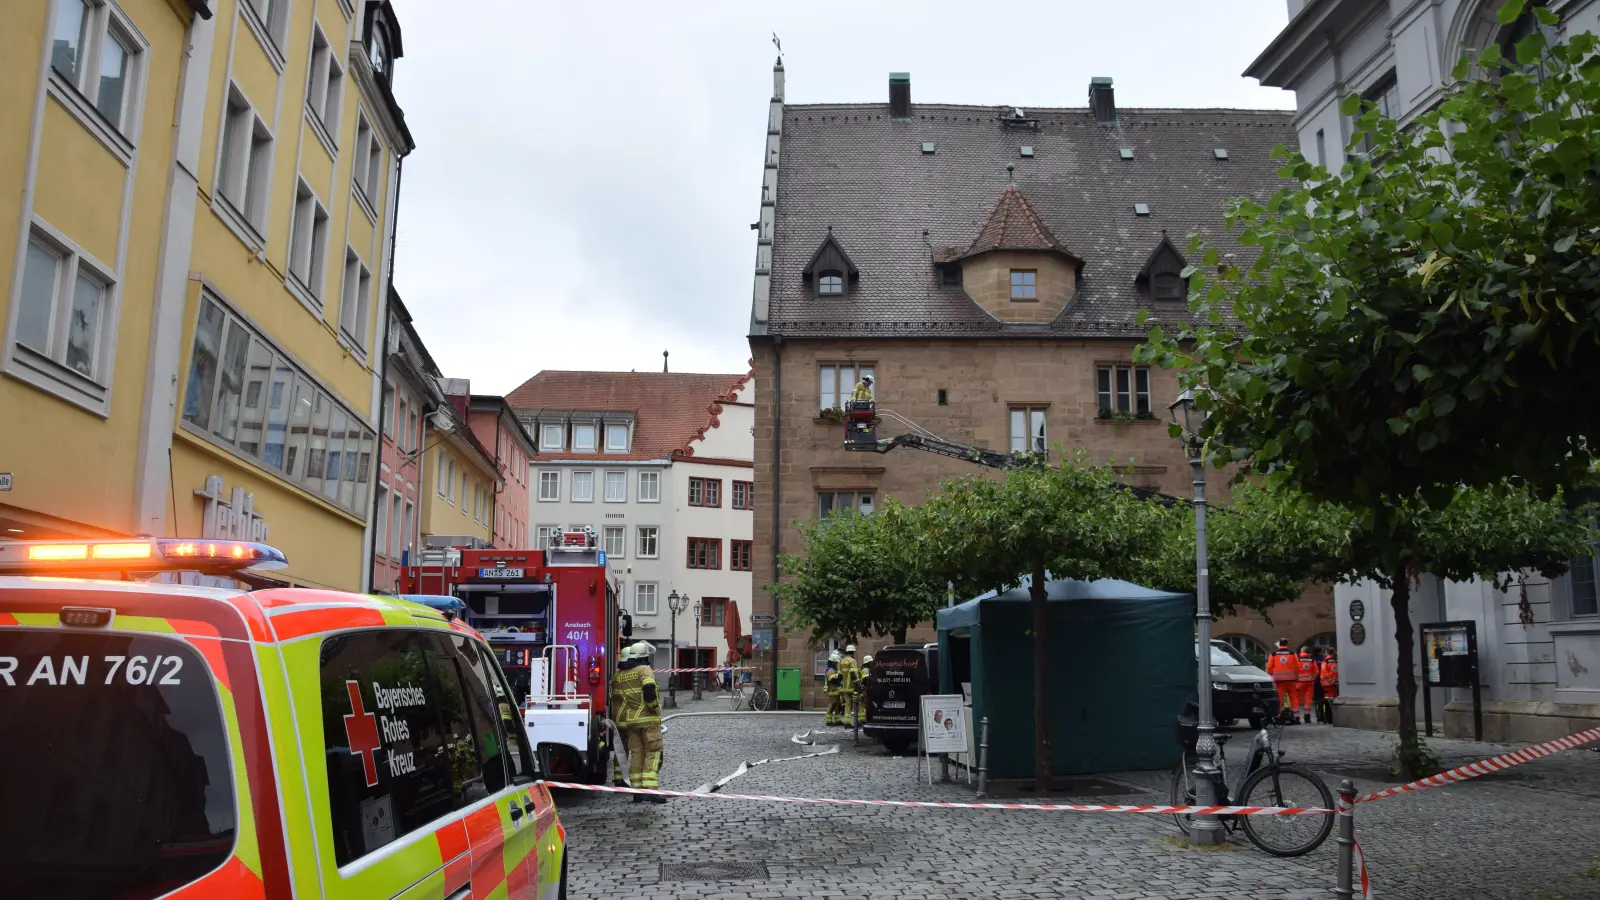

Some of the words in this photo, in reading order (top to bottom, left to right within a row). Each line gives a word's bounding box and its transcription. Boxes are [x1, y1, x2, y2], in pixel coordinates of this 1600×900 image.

[484, 569, 494, 577] AN
[506, 569, 520, 577] 261
[566, 630, 589, 641] 40/1
[27, 655, 89, 686] AN
[104, 655, 183, 686] 76/2
[373, 682, 426, 714] Bayerisches
[381, 716, 409, 743] Rotes
[387, 749, 416, 777] Kreuz
